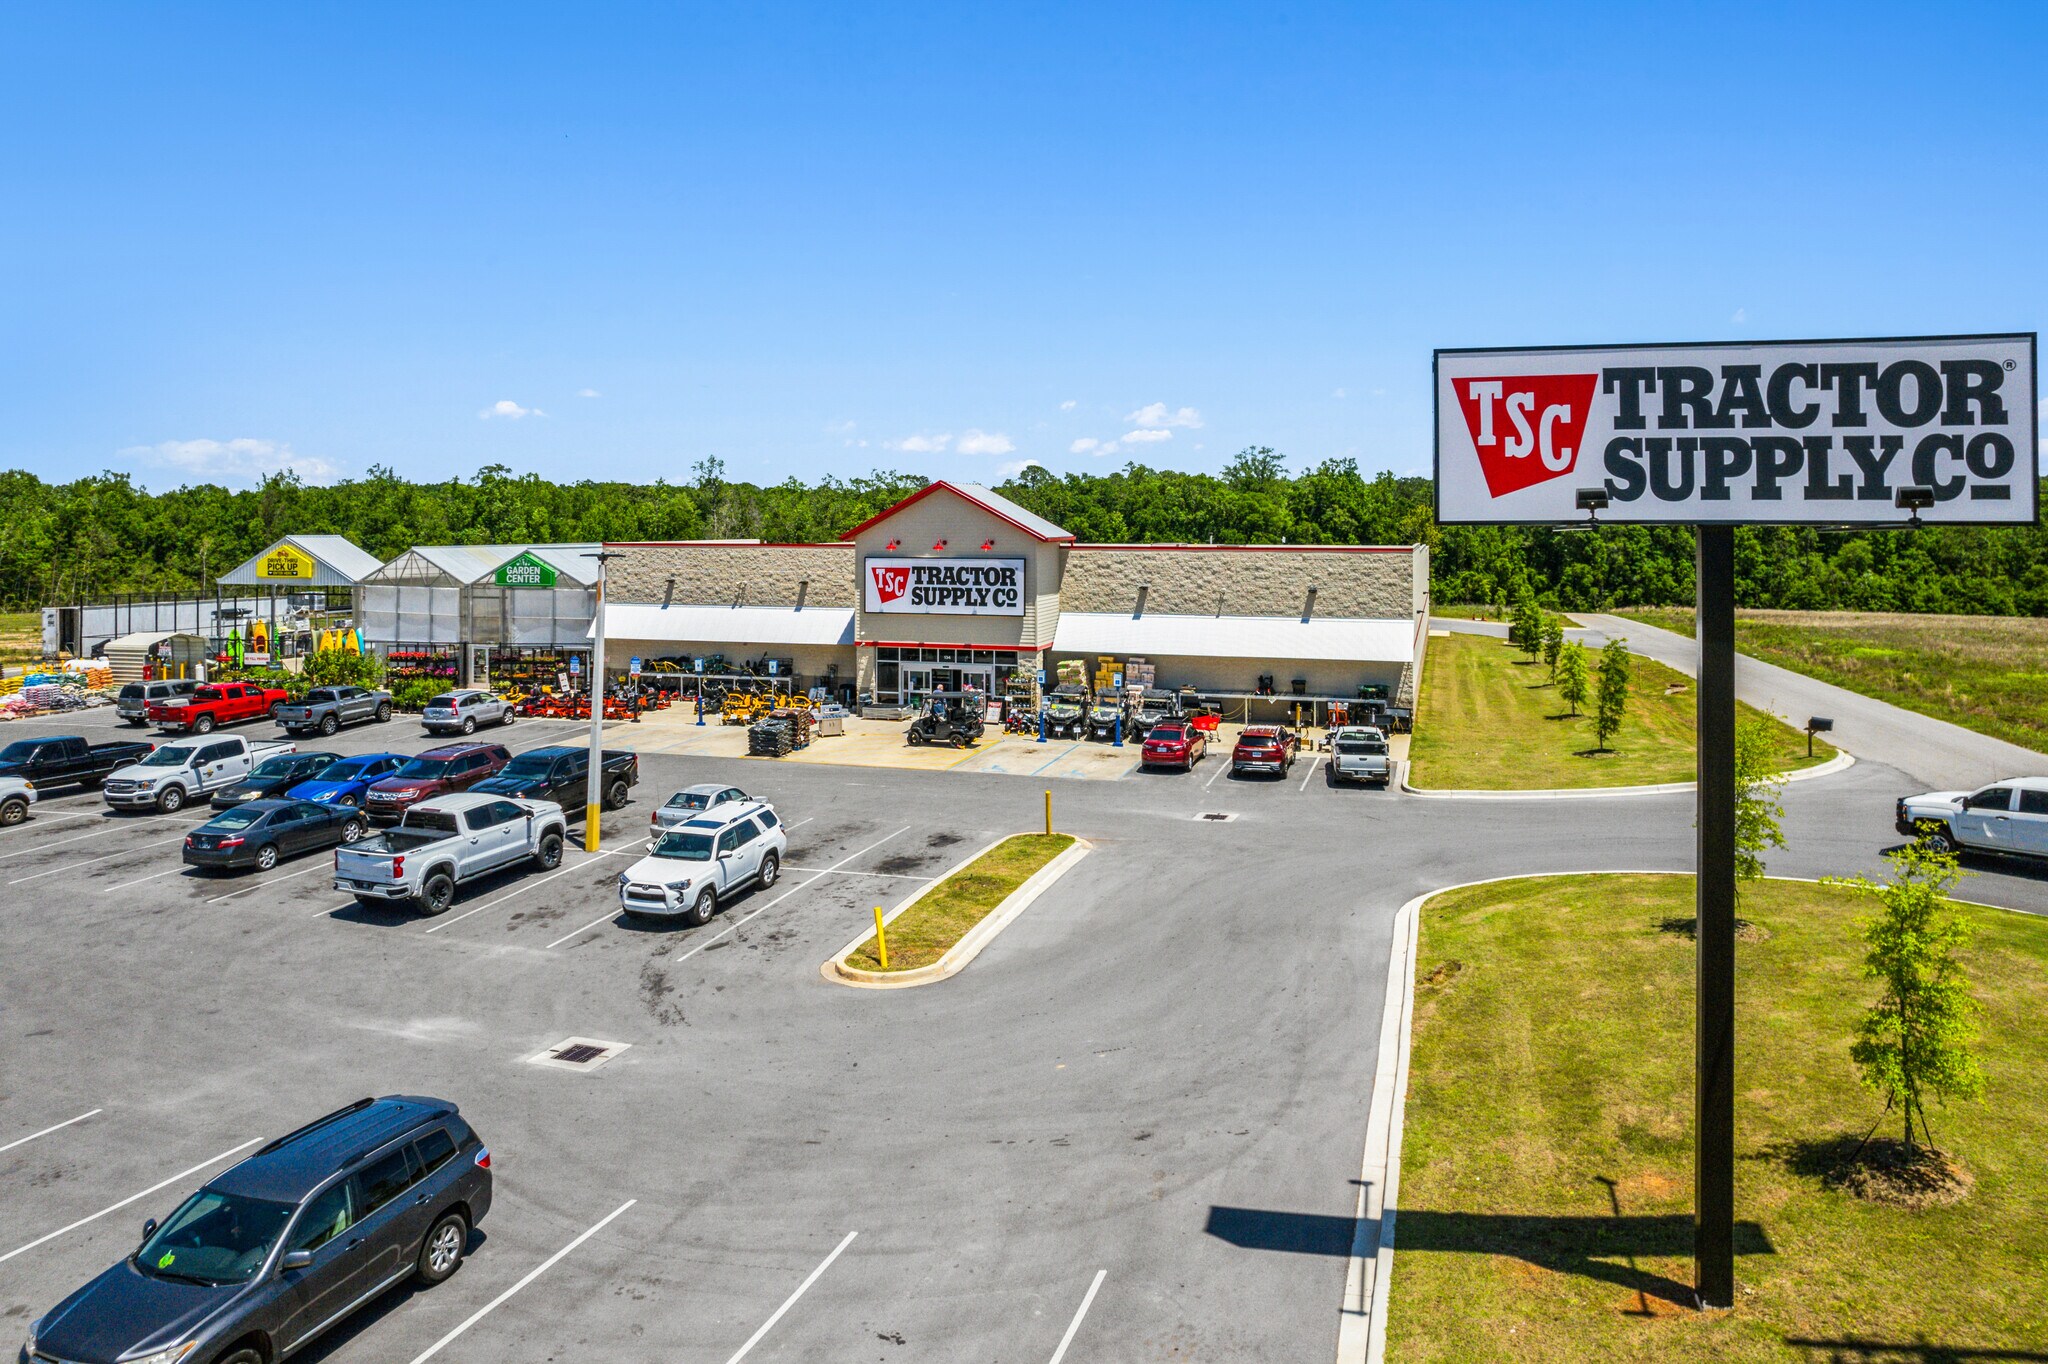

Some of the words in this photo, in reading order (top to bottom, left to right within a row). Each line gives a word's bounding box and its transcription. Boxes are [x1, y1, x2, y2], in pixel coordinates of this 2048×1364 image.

[1602, 359, 2009, 430] TRACTOR
[1469, 380, 1573, 472] TSC
[1603, 435, 1904, 502] SUPPLY
[267, 563, 285, 571] PICK
[287, 563, 298, 571] UP
[506, 566, 540, 575] GARDEN
[911, 566, 1017, 587] TRACTOR
[506, 574, 540, 583] CENTER
[876, 568, 904, 597] TSC
[911, 586, 991, 607] SUPPLY
